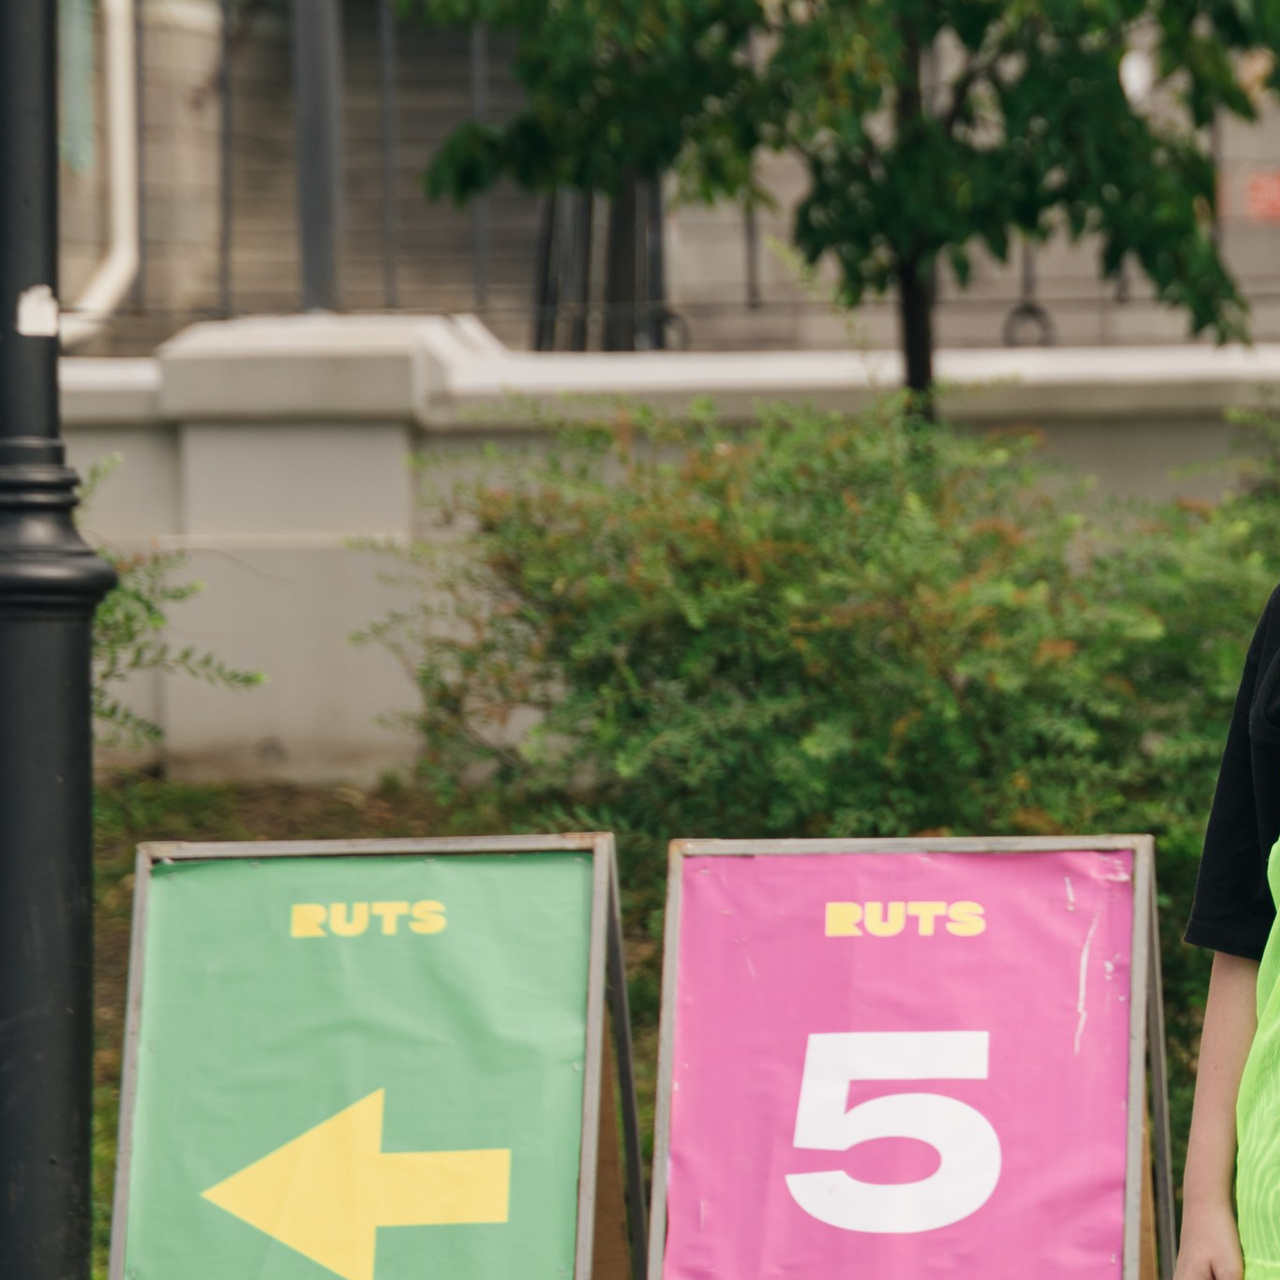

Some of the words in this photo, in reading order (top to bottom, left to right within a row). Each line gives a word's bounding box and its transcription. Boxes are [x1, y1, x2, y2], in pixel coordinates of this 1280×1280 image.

[290, 900, 447, 939] RUTS
[825, 901, 986, 937] RUTS
[785, 1030, 1002, 1234] 5
